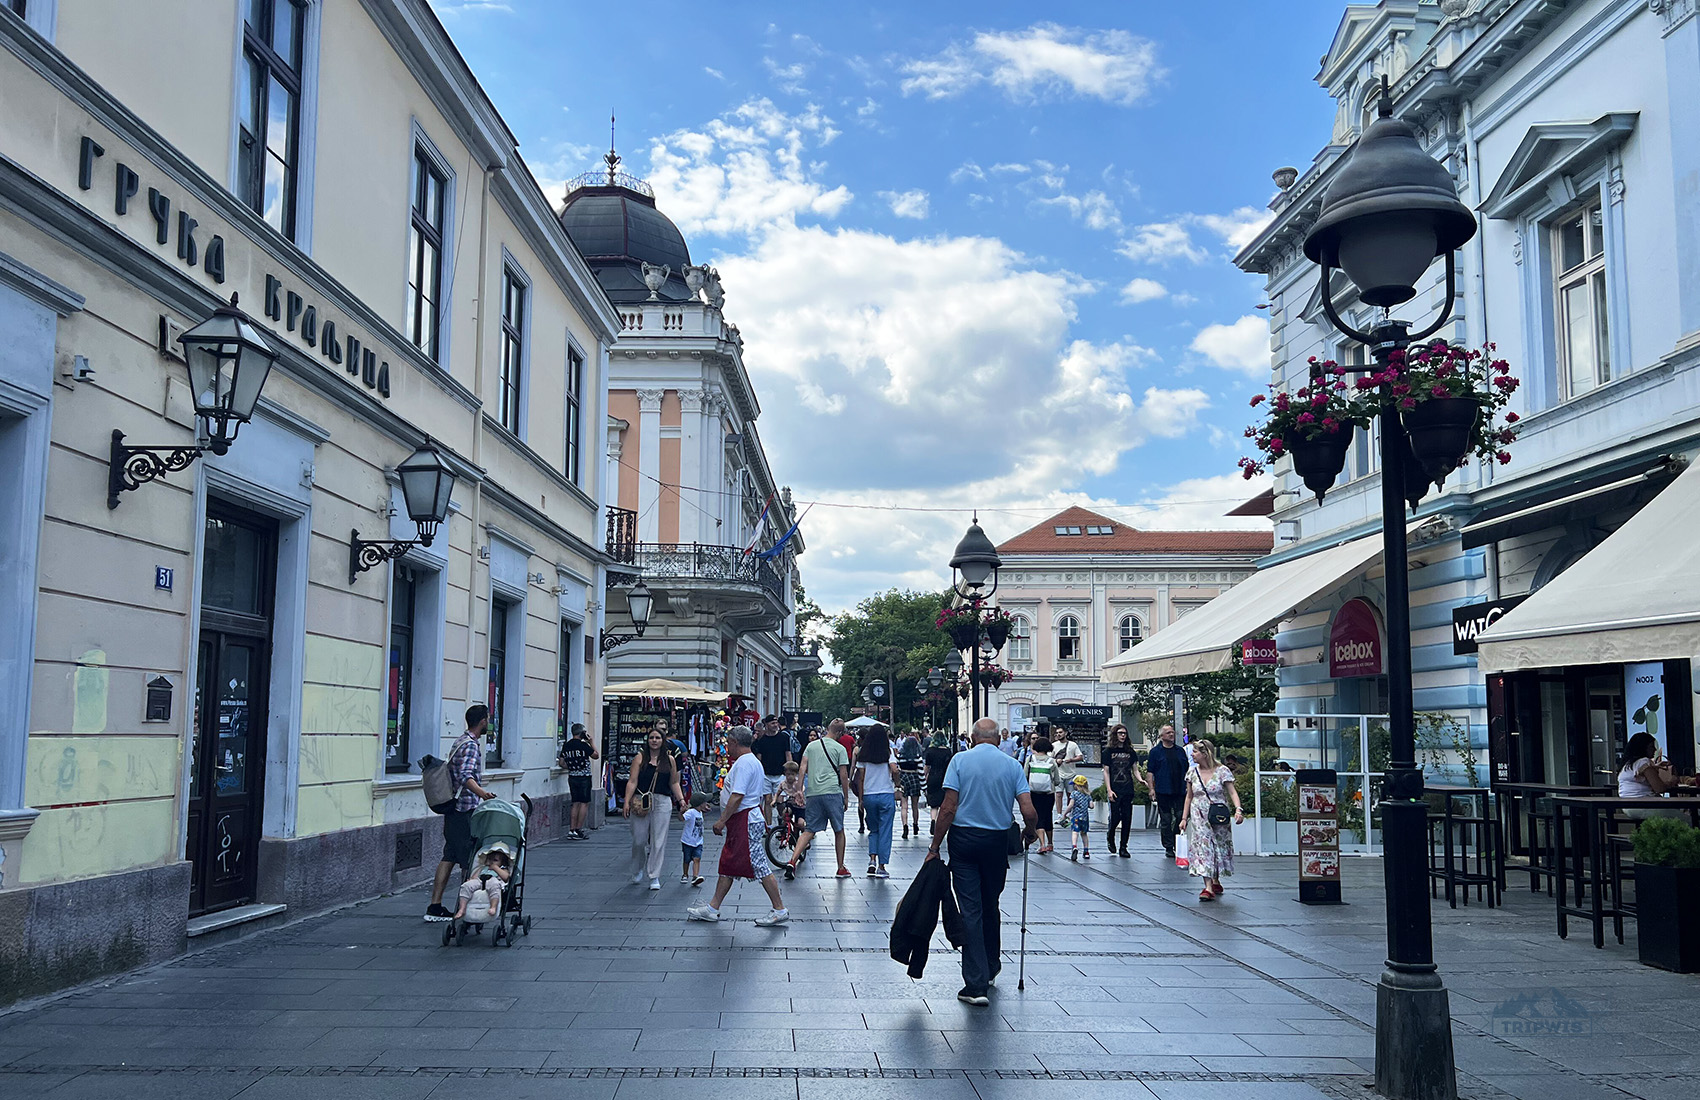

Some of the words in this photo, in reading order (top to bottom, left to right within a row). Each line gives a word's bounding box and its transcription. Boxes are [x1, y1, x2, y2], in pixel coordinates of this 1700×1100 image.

[78, 135, 227, 284] ГРЧКА
[265, 273, 391, 399] КРАЉИЦА
[159, 568, 171, 587] 51
[1334, 639, 1374, 663] icebox
[1062, 708, 1104, 716] SOUVENIRS
